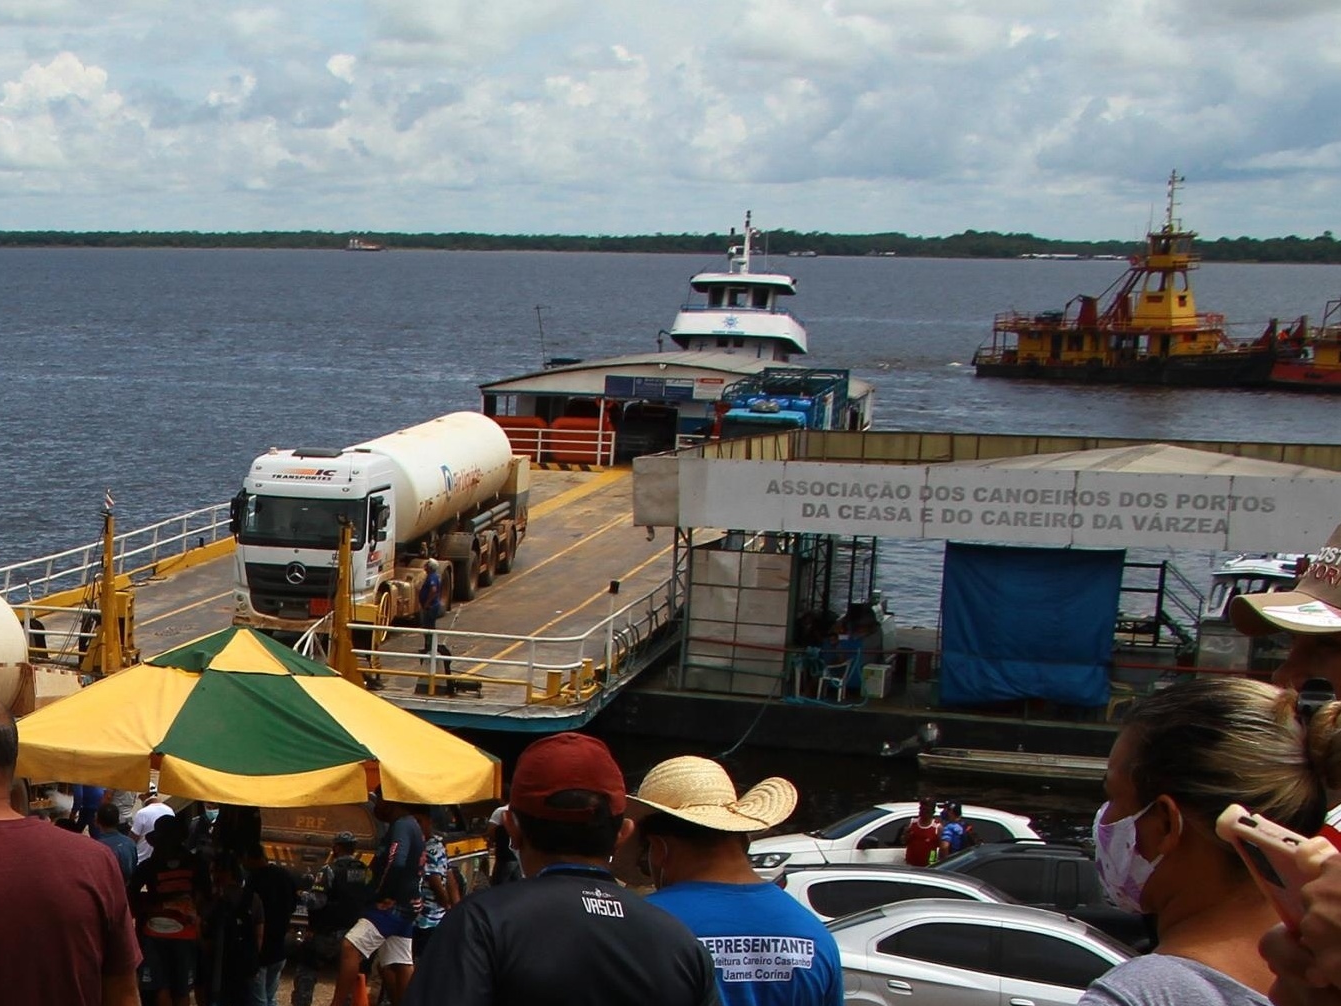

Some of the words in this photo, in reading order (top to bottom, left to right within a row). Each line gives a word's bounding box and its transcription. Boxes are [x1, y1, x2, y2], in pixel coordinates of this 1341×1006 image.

[766, 480, 910, 502] ASSOCIAÇÃO
[919, 486, 965, 502] DOS
[973, 487, 1110, 508] CANOEIROS
[1119, 491, 1168, 510] DOS
[1176, 494, 1275, 514] PORTOS
[802, 503, 830, 518] DA
[838, 504, 912, 522] CEASA
[920, 507, 933, 523] E
[941, 508, 973, 524] DO
[981, 509, 1084, 529] CAREIRO
[1092, 514, 1123, 531] DA
[1132, 512, 1229, 535] VÁRZEA
[296, 816, 326, 829] PRF
[581, 896, 625, 918] VASCO
[703, 938, 813, 955] EPRESENTANTE
[715, 957, 741, 967] feitura
[743, 956, 772, 966] Careiro
[774, 956, 811, 967] Castanho
[724, 970, 752, 980] James
[755, 969, 790, 980] Corina
